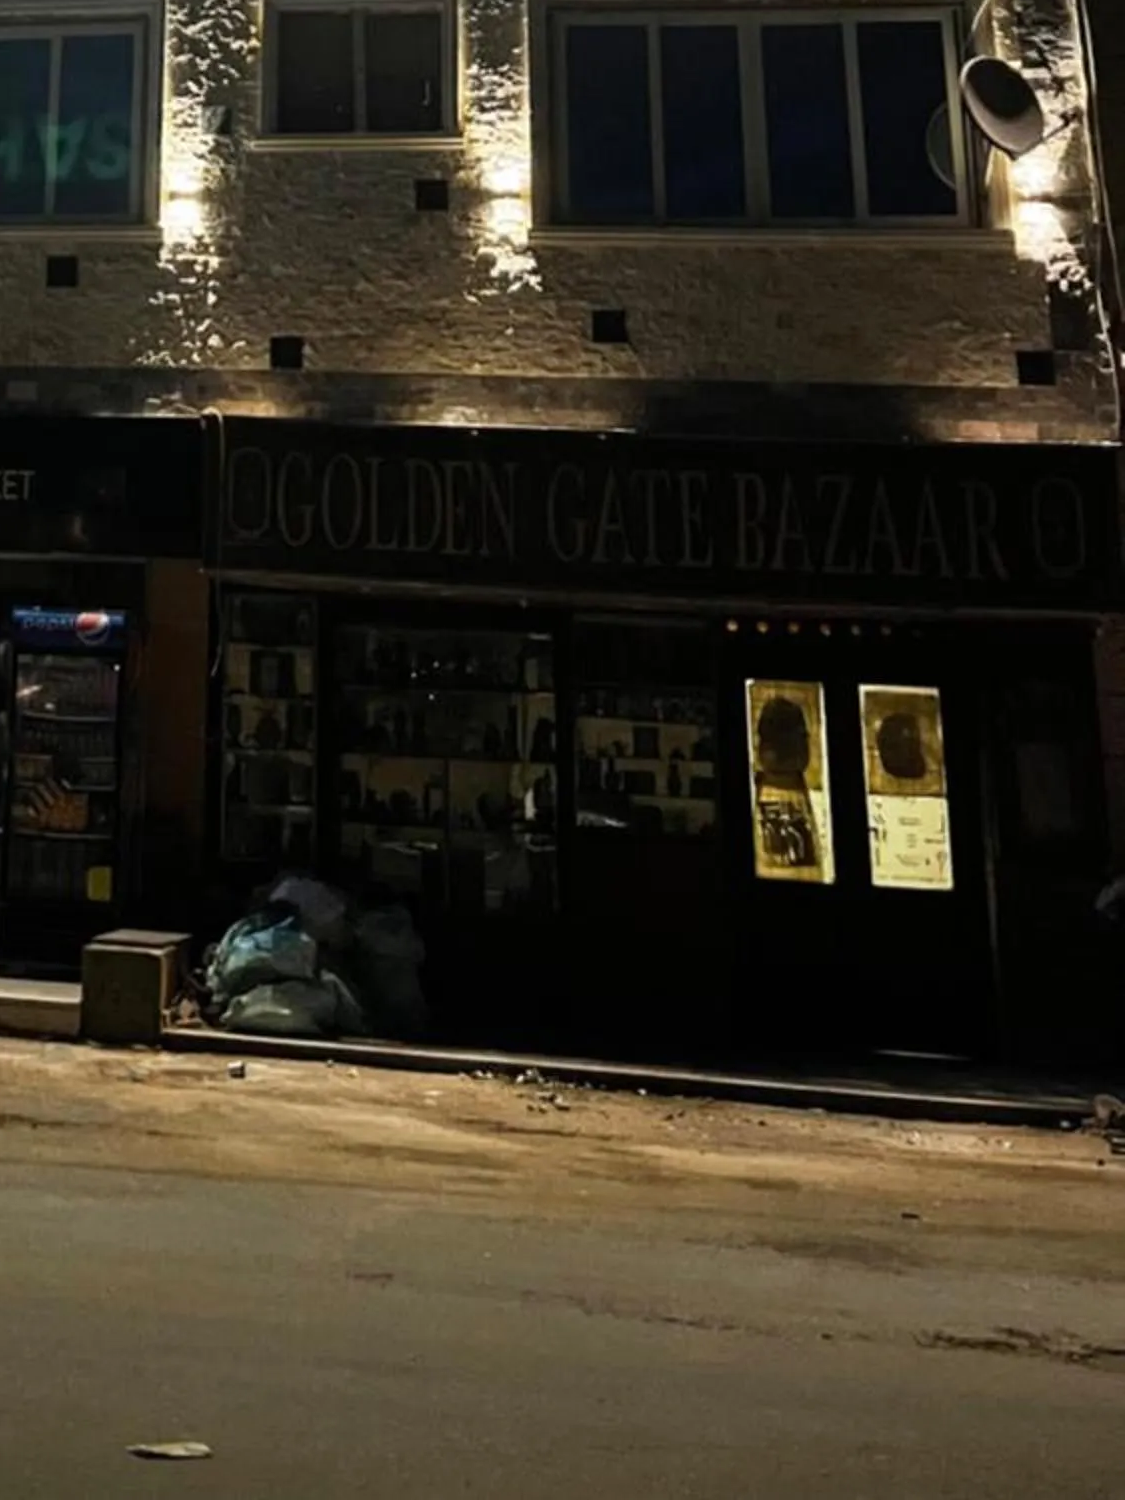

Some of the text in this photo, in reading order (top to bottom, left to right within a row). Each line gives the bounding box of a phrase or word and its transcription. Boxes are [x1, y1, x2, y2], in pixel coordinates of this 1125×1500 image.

[276, 451, 1012, 581] GOLDEN GATE BAZAAR
